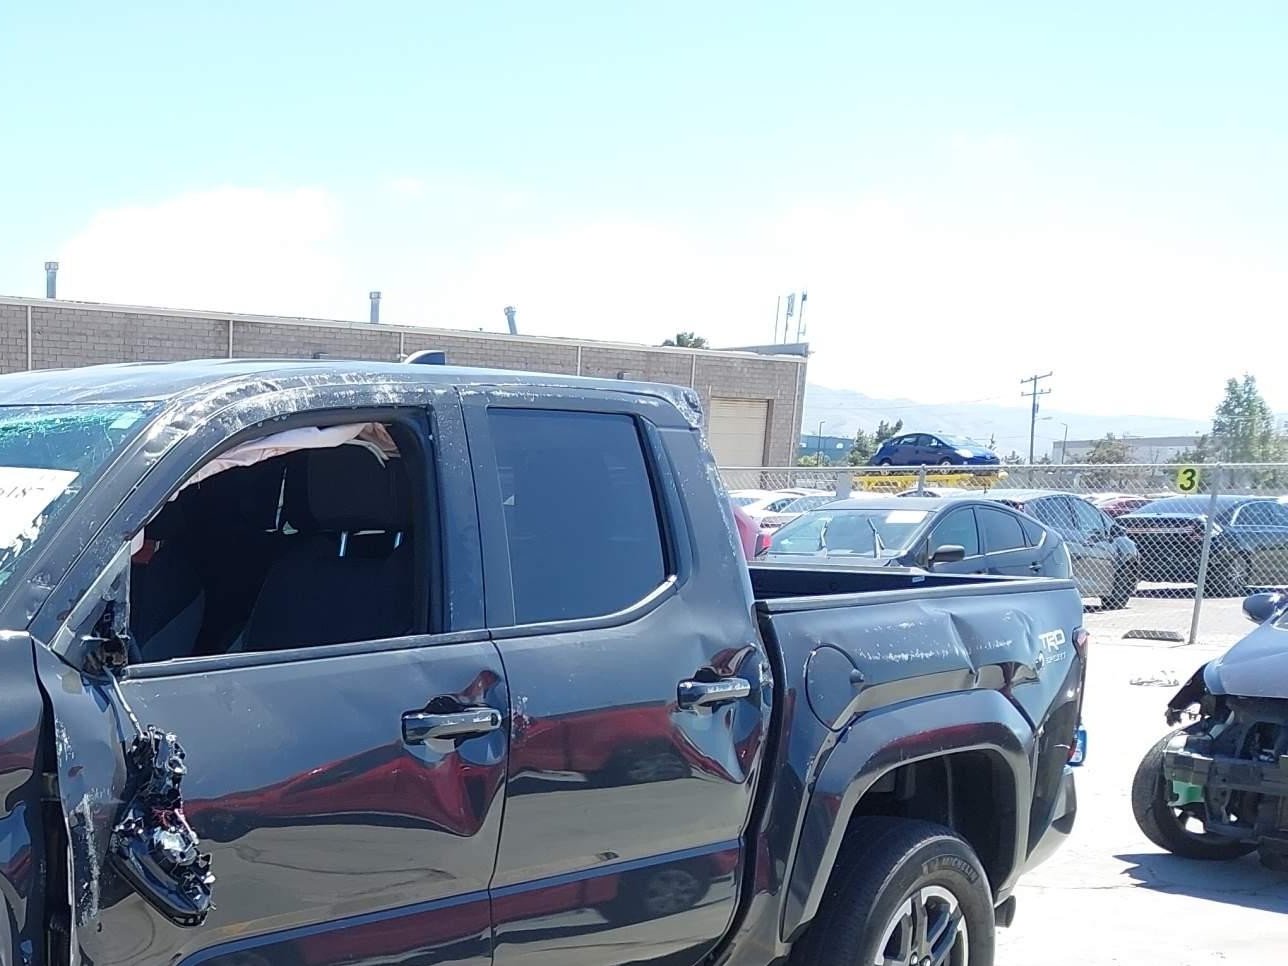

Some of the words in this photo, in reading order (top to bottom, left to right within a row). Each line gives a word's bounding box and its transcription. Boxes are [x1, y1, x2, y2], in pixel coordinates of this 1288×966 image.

[1179, 468, 1196, 491] 3
[1038, 629, 1066, 652] TRD
[941, 855, 979, 882] MICHELIN
